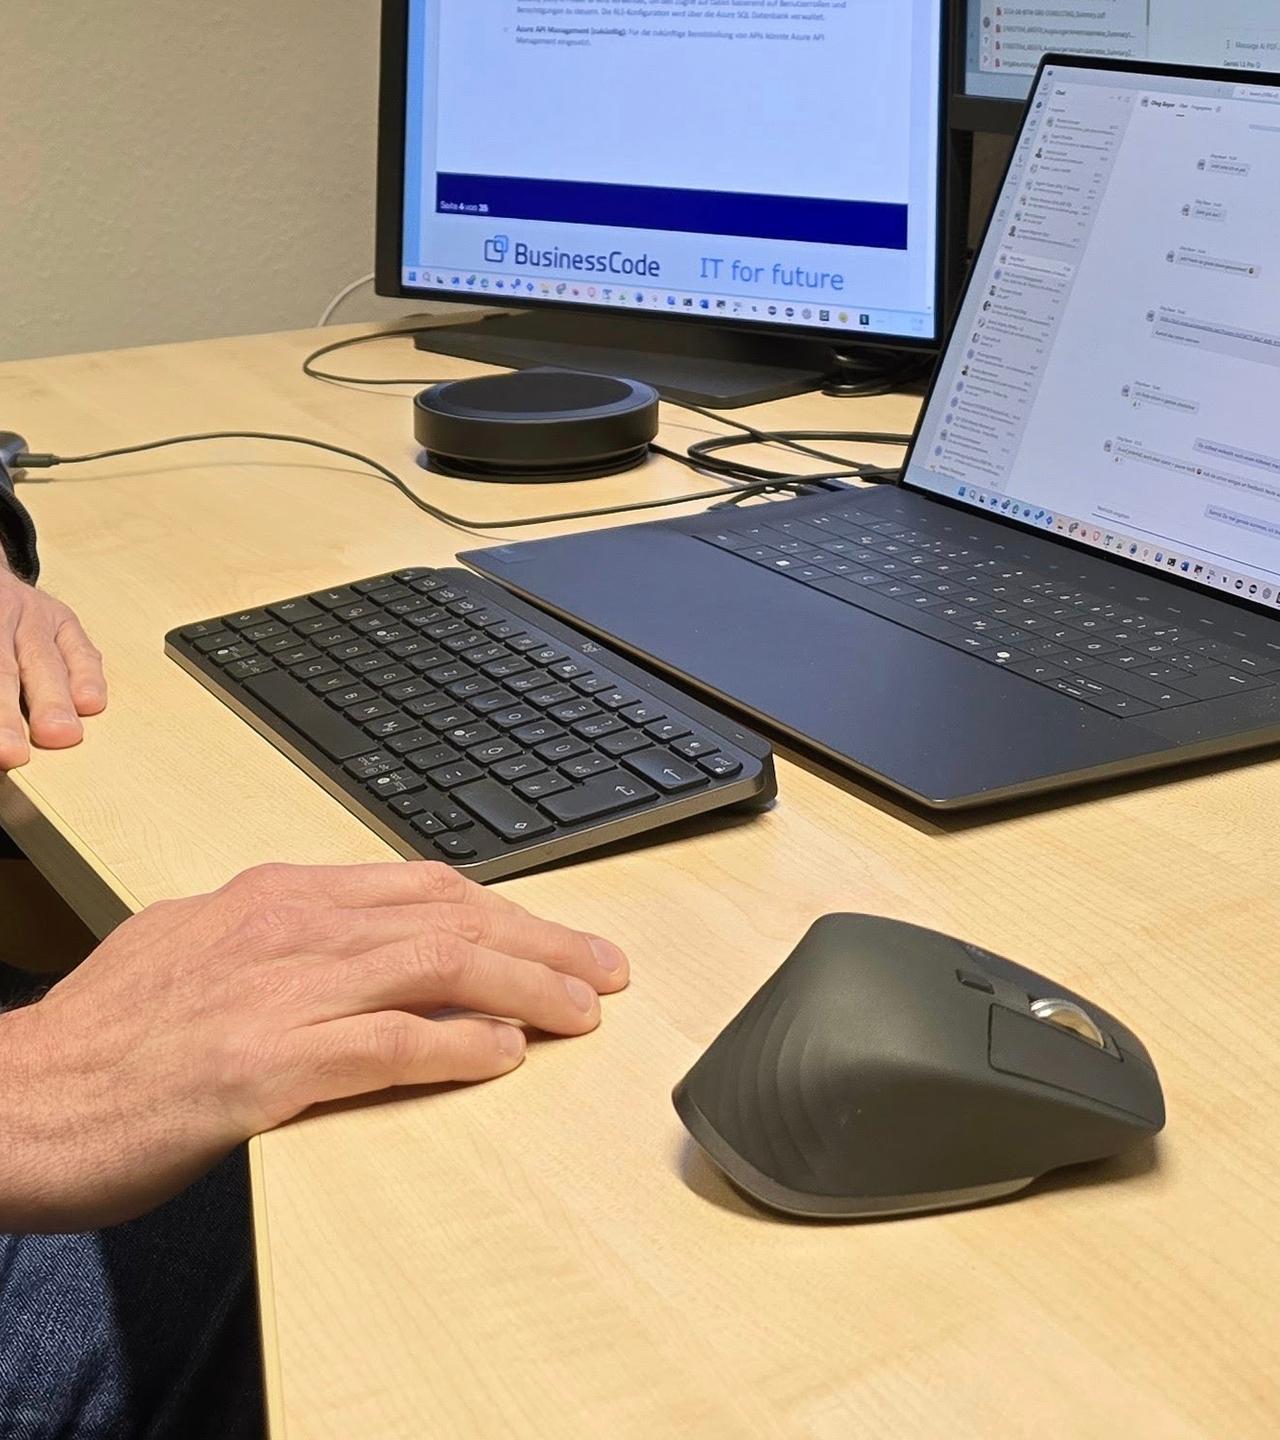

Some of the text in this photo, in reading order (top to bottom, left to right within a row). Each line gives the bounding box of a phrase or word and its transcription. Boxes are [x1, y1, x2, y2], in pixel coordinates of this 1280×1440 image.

[514, 243, 661, 278] BusinessCode
[699, 257, 845, 291] IT for future
